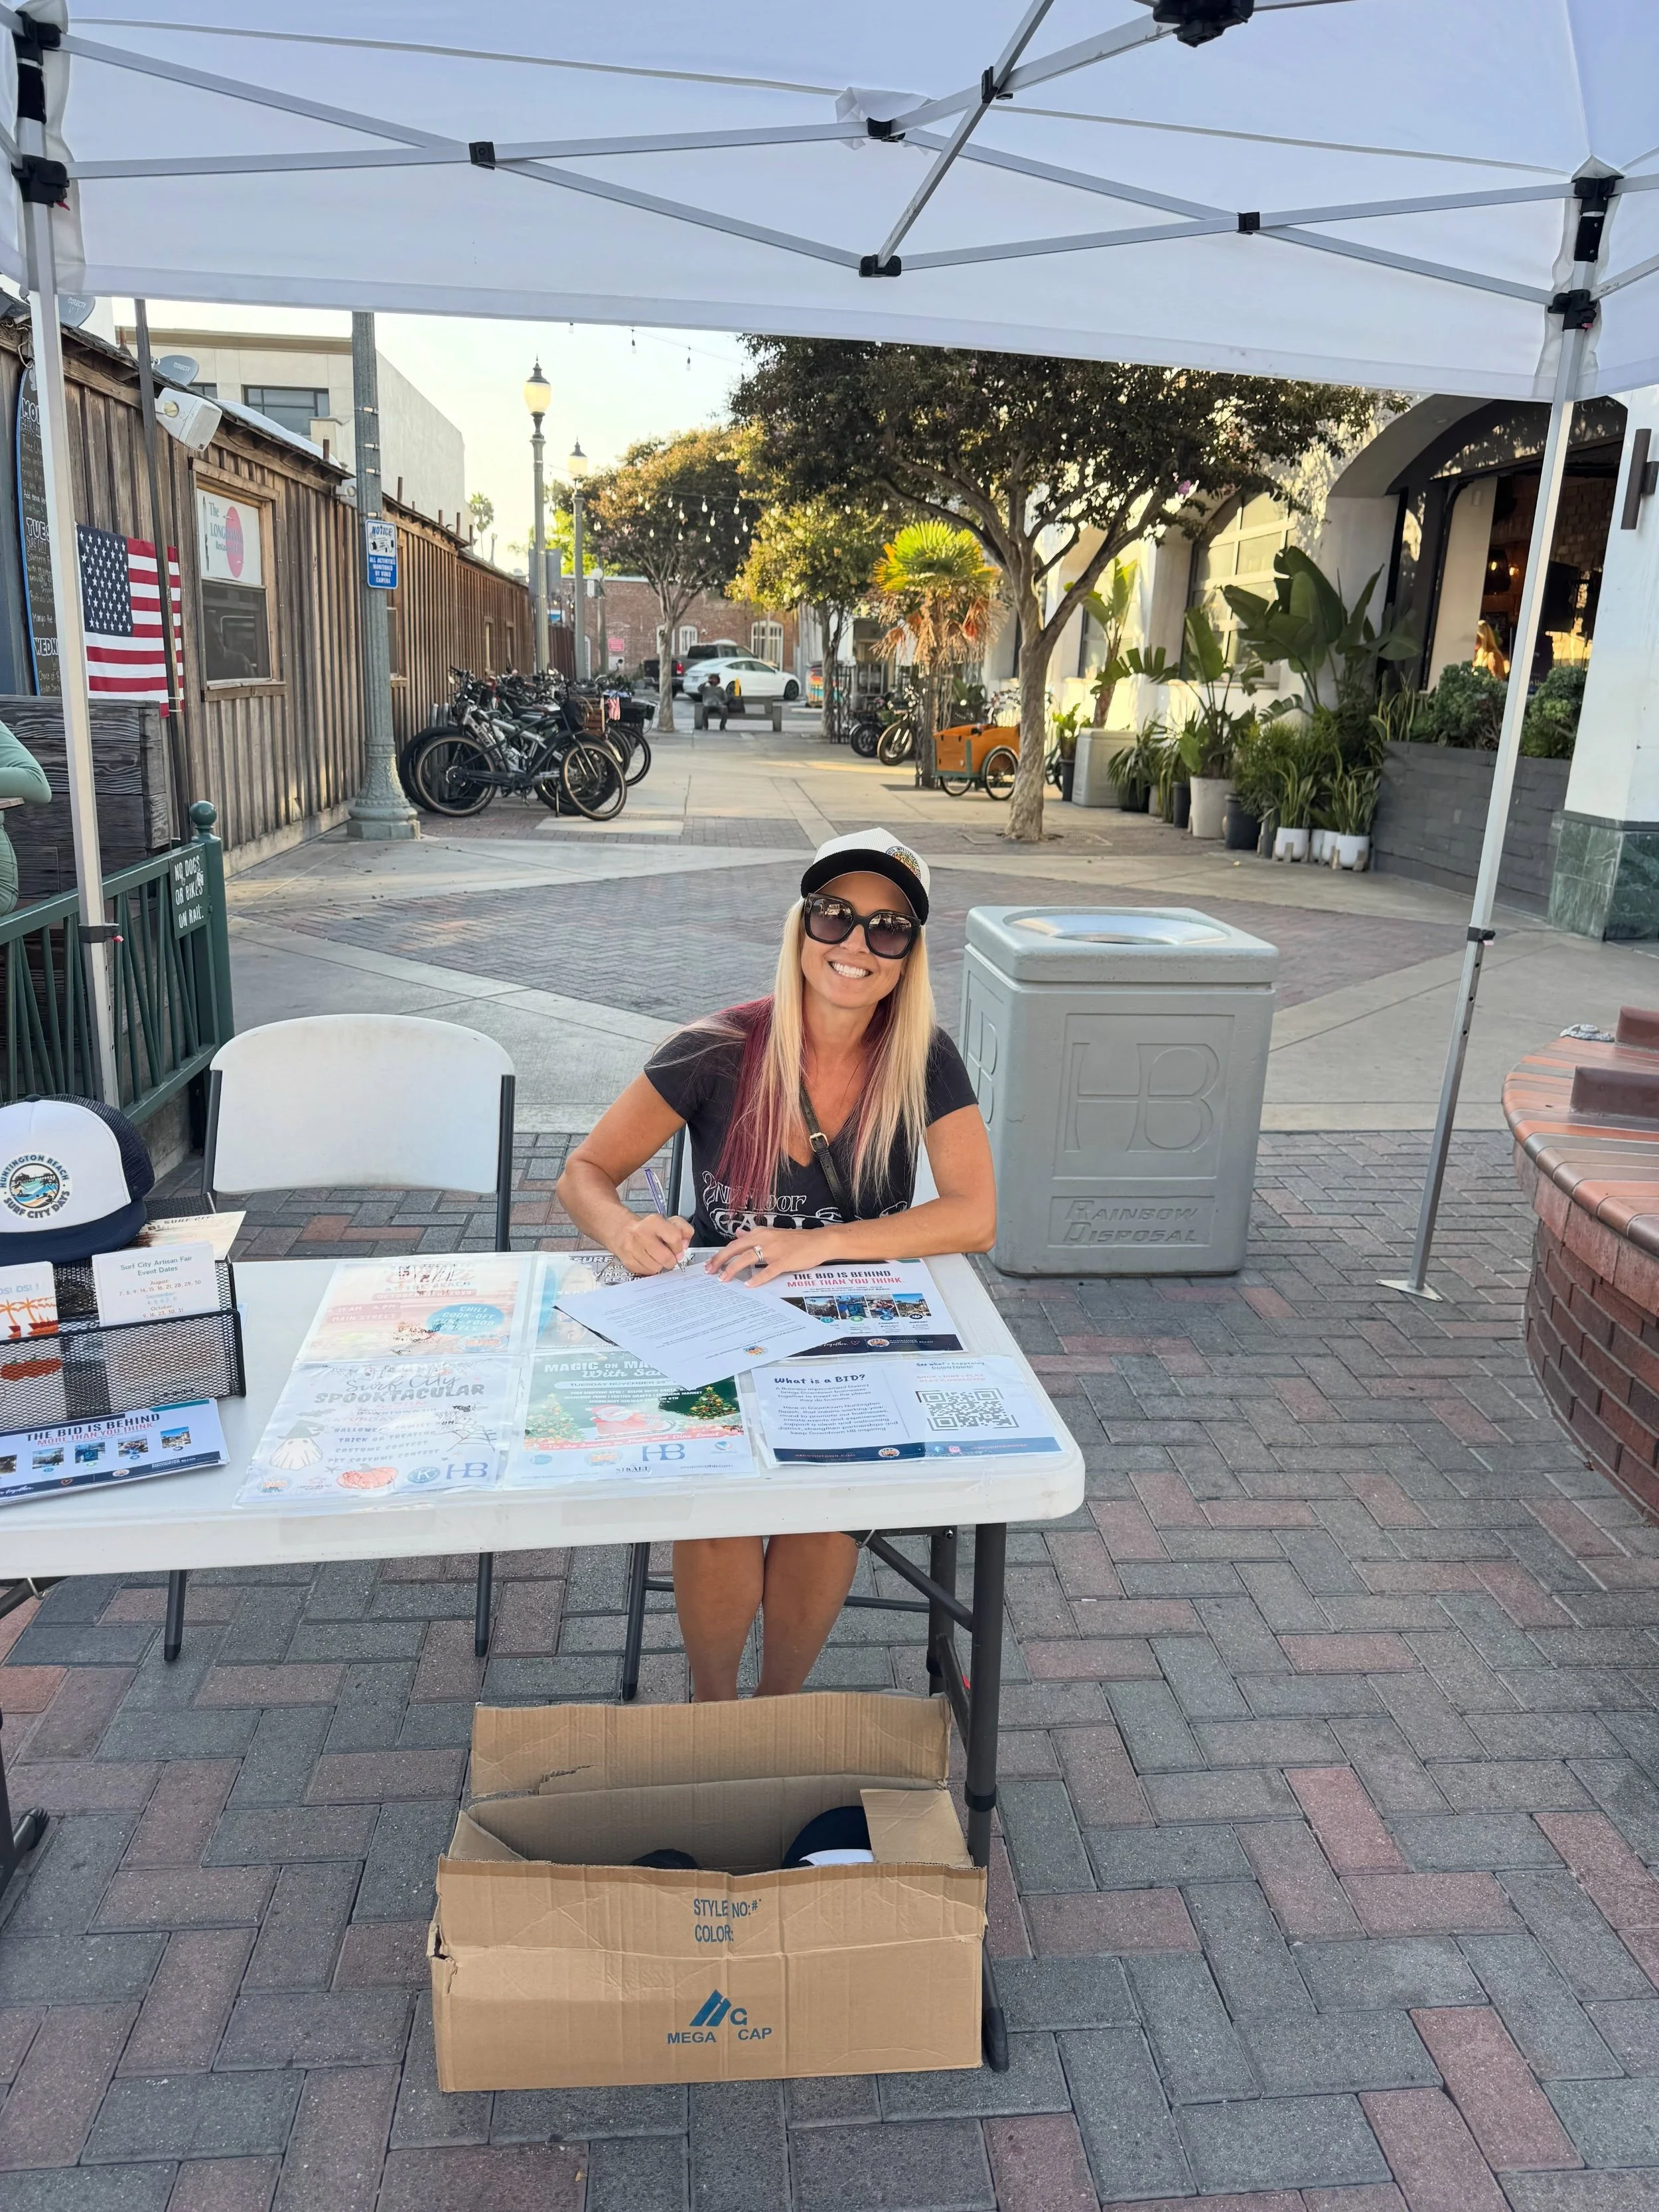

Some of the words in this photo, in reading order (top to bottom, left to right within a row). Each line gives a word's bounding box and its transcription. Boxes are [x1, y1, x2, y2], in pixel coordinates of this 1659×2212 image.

[209, 502, 220, 517] The
[372, 526, 392, 536] NOTICE
[175, 862, 183, 881] NO
[184, 855, 201, 877] DOGS
[175, 887, 184, 905] OR
[185, 880, 203, 901] BIKES
[179, 911, 188, 928] ON
[1065, 1043, 1220, 1153] HB
[0, 1154, 44, 1188] HUNTINGTON
[47, 1157, 69, 1181] BEACH
[3, 1197, 27, 1216] SURF
[27, 1208, 50, 1218] CITY
[51, 1191, 70, 1213] DAYS
[1064, 1200, 1198, 1221] RAINBOW
[1063, 1222, 1198, 1242] DISPOSAL
[544, 1362, 599, 1373] MAGIC
[581, 1368, 628, 1378] With
[346, 1375, 405, 1392] Surf
[409, 1373, 463, 1388] City
[314, 1384, 485, 1404] SPOOKTACULAR
[27, 1429, 52, 1442] THE
[57, 1425, 82, 1437] BID
[88, 1422, 102, 1432] IS
[106, 1413, 161, 1429] BEHIND
[390, 1430, 436, 1439] TREATING
[36, 1436, 68, 1446] MORE
[71, 1432, 97, 1441] THAN
[100, 1428, 121, 1438] YOU
[386, 1440, 429, 1450] CONTEST
[397, 1449, 440, 1459] CONTEST
[642, 1443, 685, 1461] HB
[446, 1462, 488, 1480] HB
[693, 1898, 729, 1917] STYLE
[695, 1924, 734, 1943] COLOR:
[667, 2031, 717, 2045] MEGA
[738, 2028, 772, 2041] CAP
